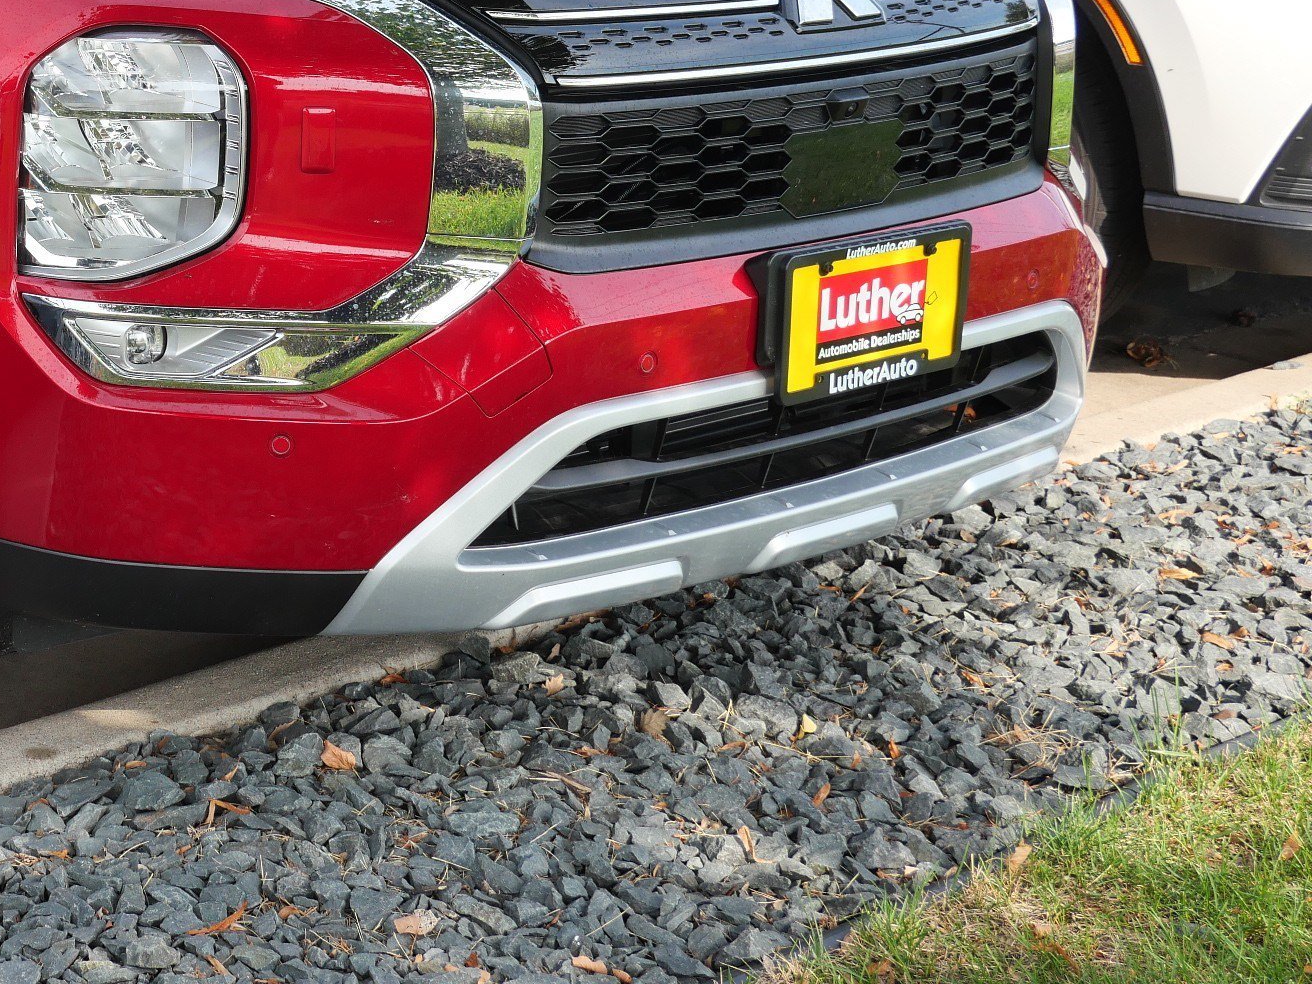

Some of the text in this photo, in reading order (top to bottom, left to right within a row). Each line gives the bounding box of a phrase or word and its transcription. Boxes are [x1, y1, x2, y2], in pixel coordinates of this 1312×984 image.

[846, 239, 916, 259] LutherAuto.com
[820, 278, 925, 331] Luther
[818, 328, 920, 359] Automobile Dealerships
[829, 358, 917, 394] LutherAuto
